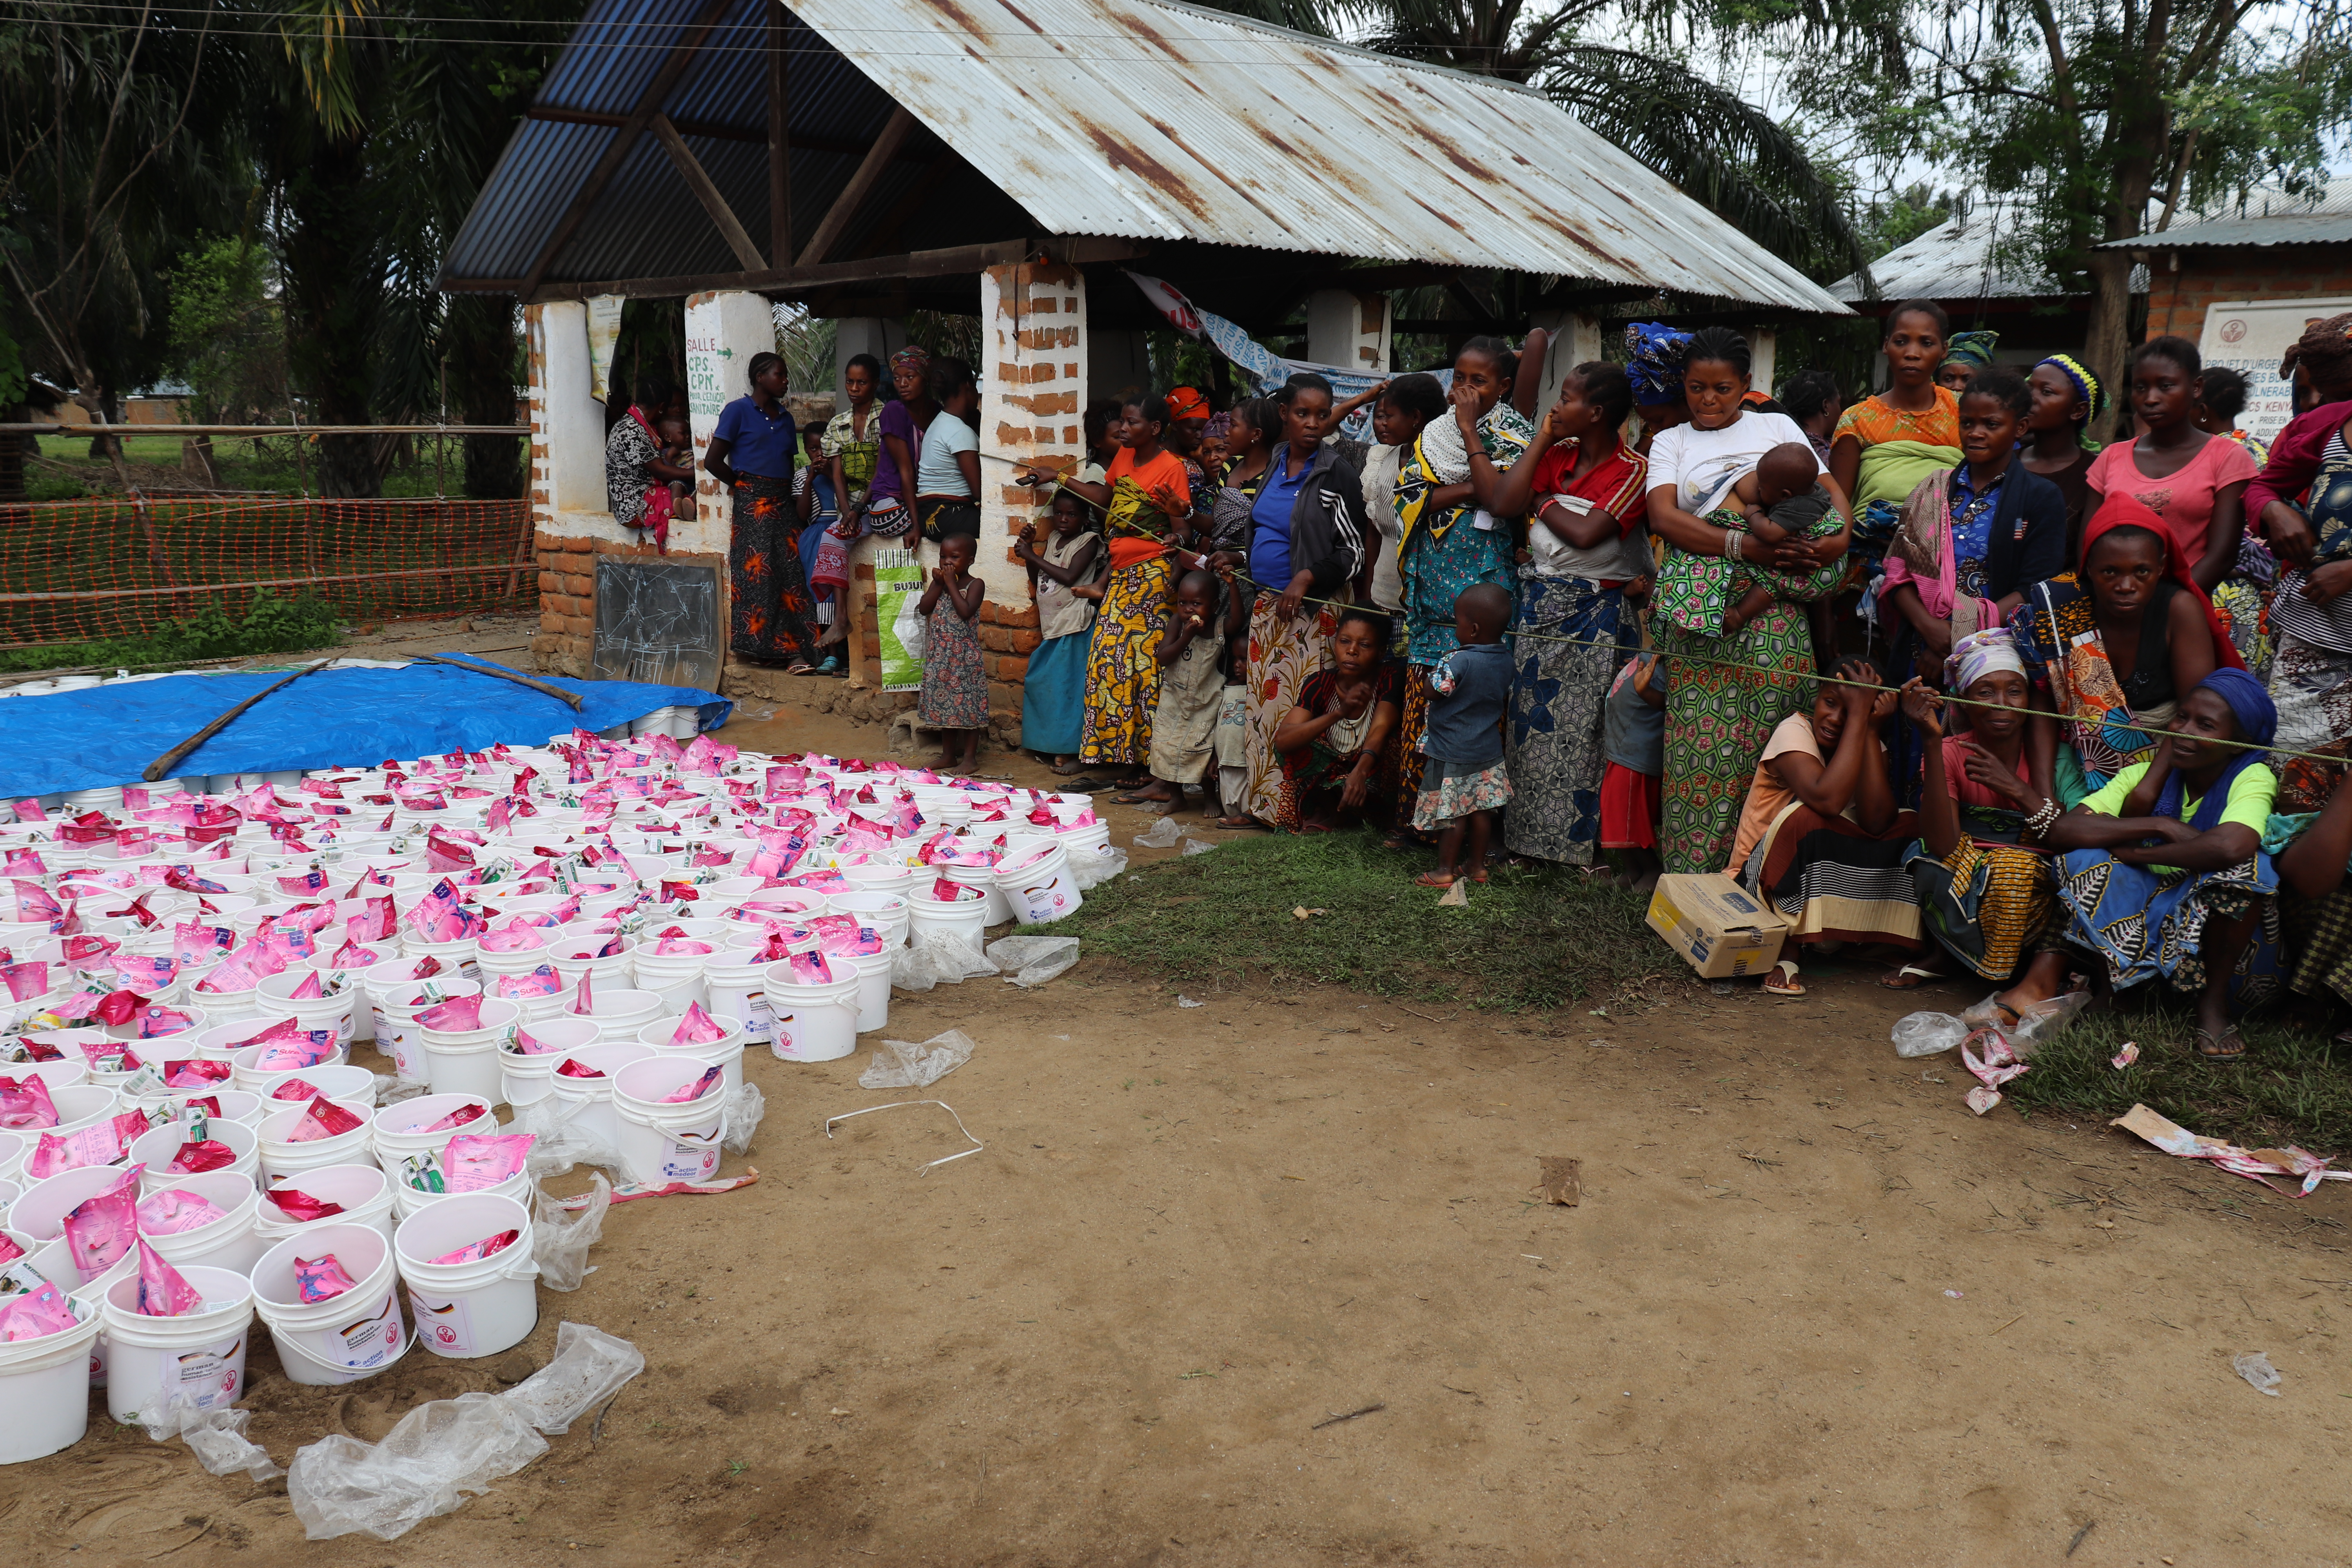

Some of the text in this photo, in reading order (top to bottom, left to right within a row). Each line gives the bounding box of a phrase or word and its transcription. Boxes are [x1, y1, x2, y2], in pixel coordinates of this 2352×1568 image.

[688, 338, 715, 352] SALLE
[1341, 375, 1372, 385] action
[690, 391, 702, 401] POUR
[690, 401, 720, 416] SANITAIRE
[2249, 401, 2261, 412] CS
[2259, 416, 2277, 424] PRISE
[2278, 416, 2288, 424] EN
[892, 815, 907, 832] So Sure
[559, 878, 567, 894] Aloe
[428, 909, 446, 932] So Sure
[1037, 911, 1053, 919] medeor
[119, 975, 152, 985] So Sure
[520, 986, 540, 996] Sure
[428, 1010, 441, 1018] Sure
[41, 1292, 57, 1313] So Sure
[347, 1326, 374, 1343] german
[347, 1325, 381, 1347] humanitarian
[348, 1333, 376, 1350] assistance
[363, 1350, 383, 1365] action
[181, 1362, 214, 1372] german
